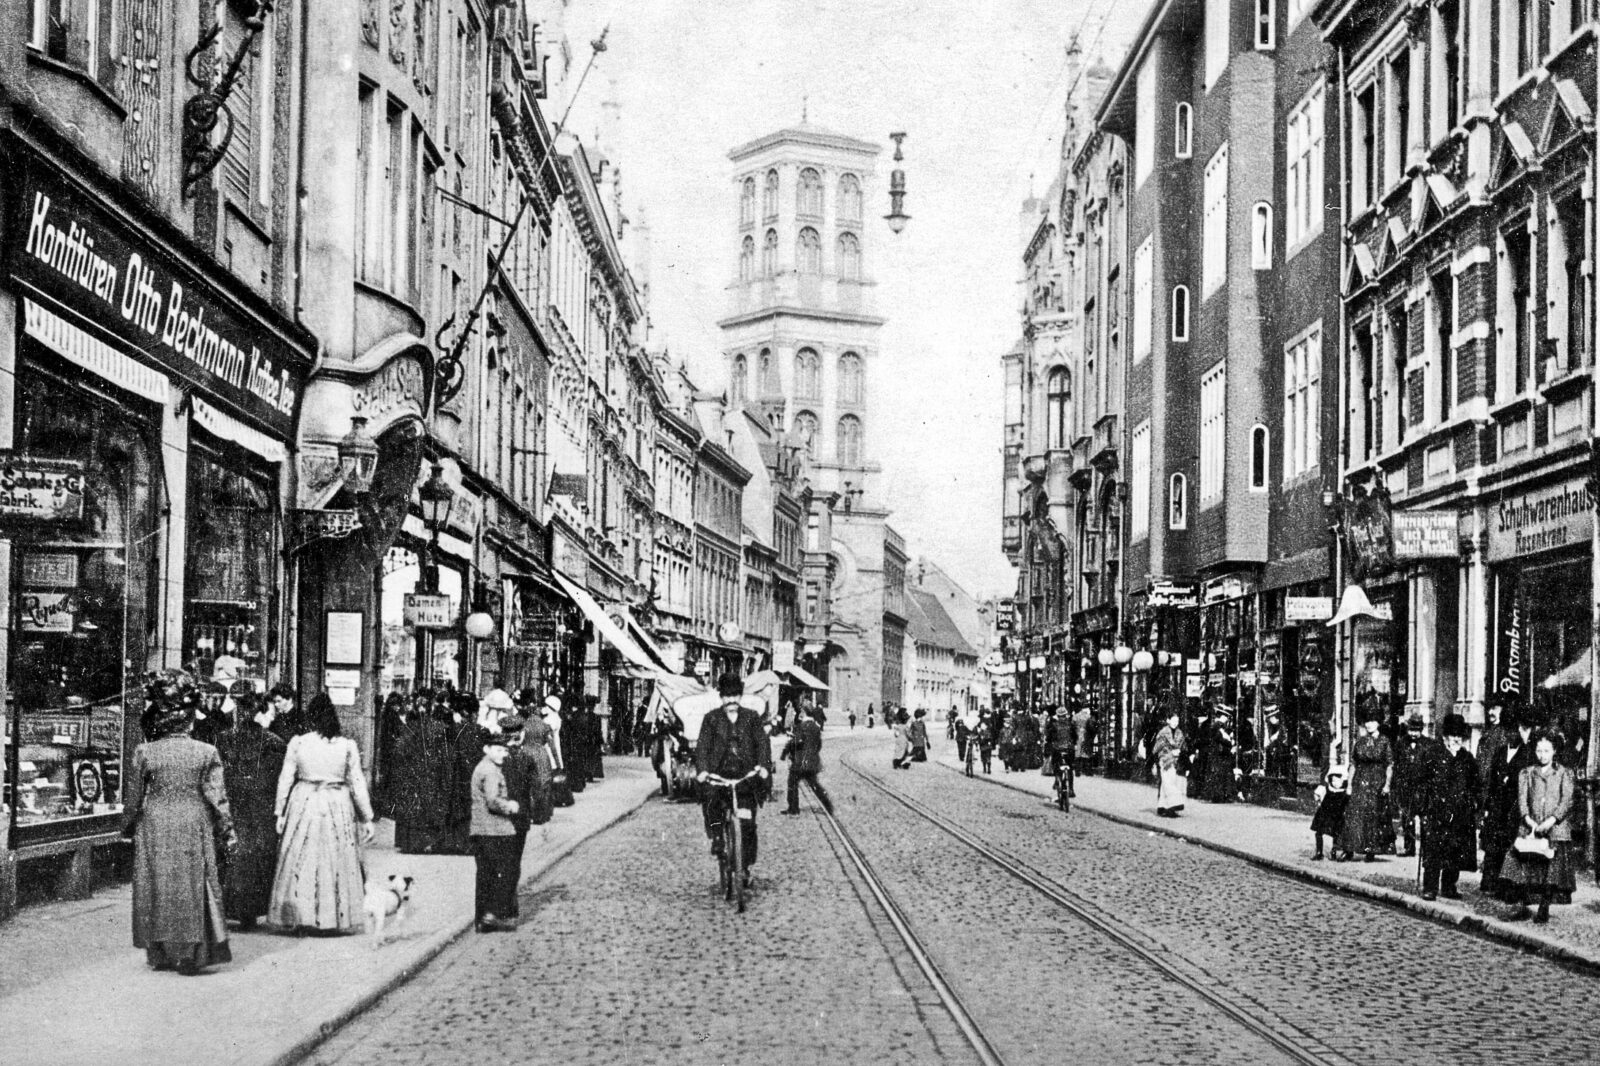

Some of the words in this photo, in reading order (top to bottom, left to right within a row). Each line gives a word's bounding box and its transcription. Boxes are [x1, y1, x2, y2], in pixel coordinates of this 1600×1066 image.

[26, 191, 117, 304] Konfitüren
[121, 252, 162, 335] Otto
[162, 281, 246, 389] Beckmann
[1498, 484, 1594, 533] Schuhwarenhaus
[1515, 526, 1567, 554] Rosenkranz
